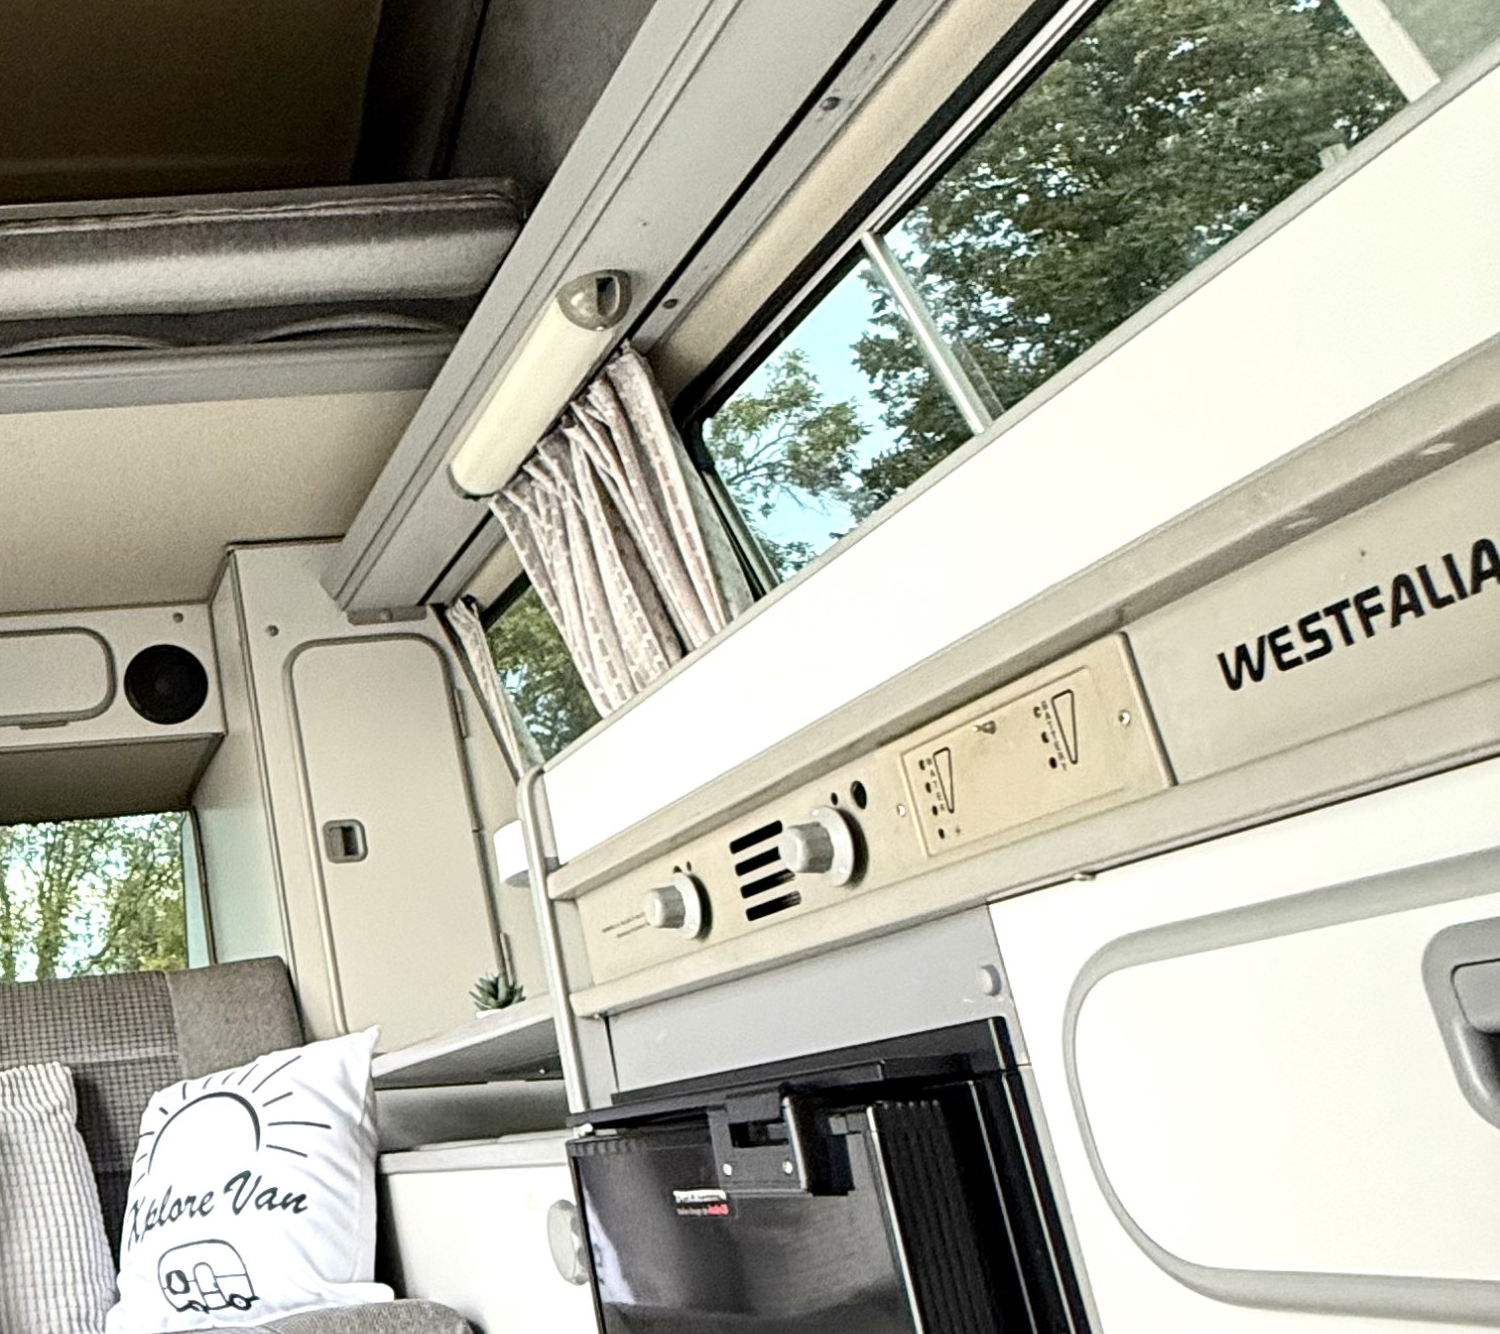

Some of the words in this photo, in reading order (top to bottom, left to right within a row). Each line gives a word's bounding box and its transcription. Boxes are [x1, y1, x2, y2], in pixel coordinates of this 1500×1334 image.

[1216, 537, 1500, 692] WESTFALIA
[126, 1184, 217, 1252] Xplore
[222, 1169, 309, 1217] Van
